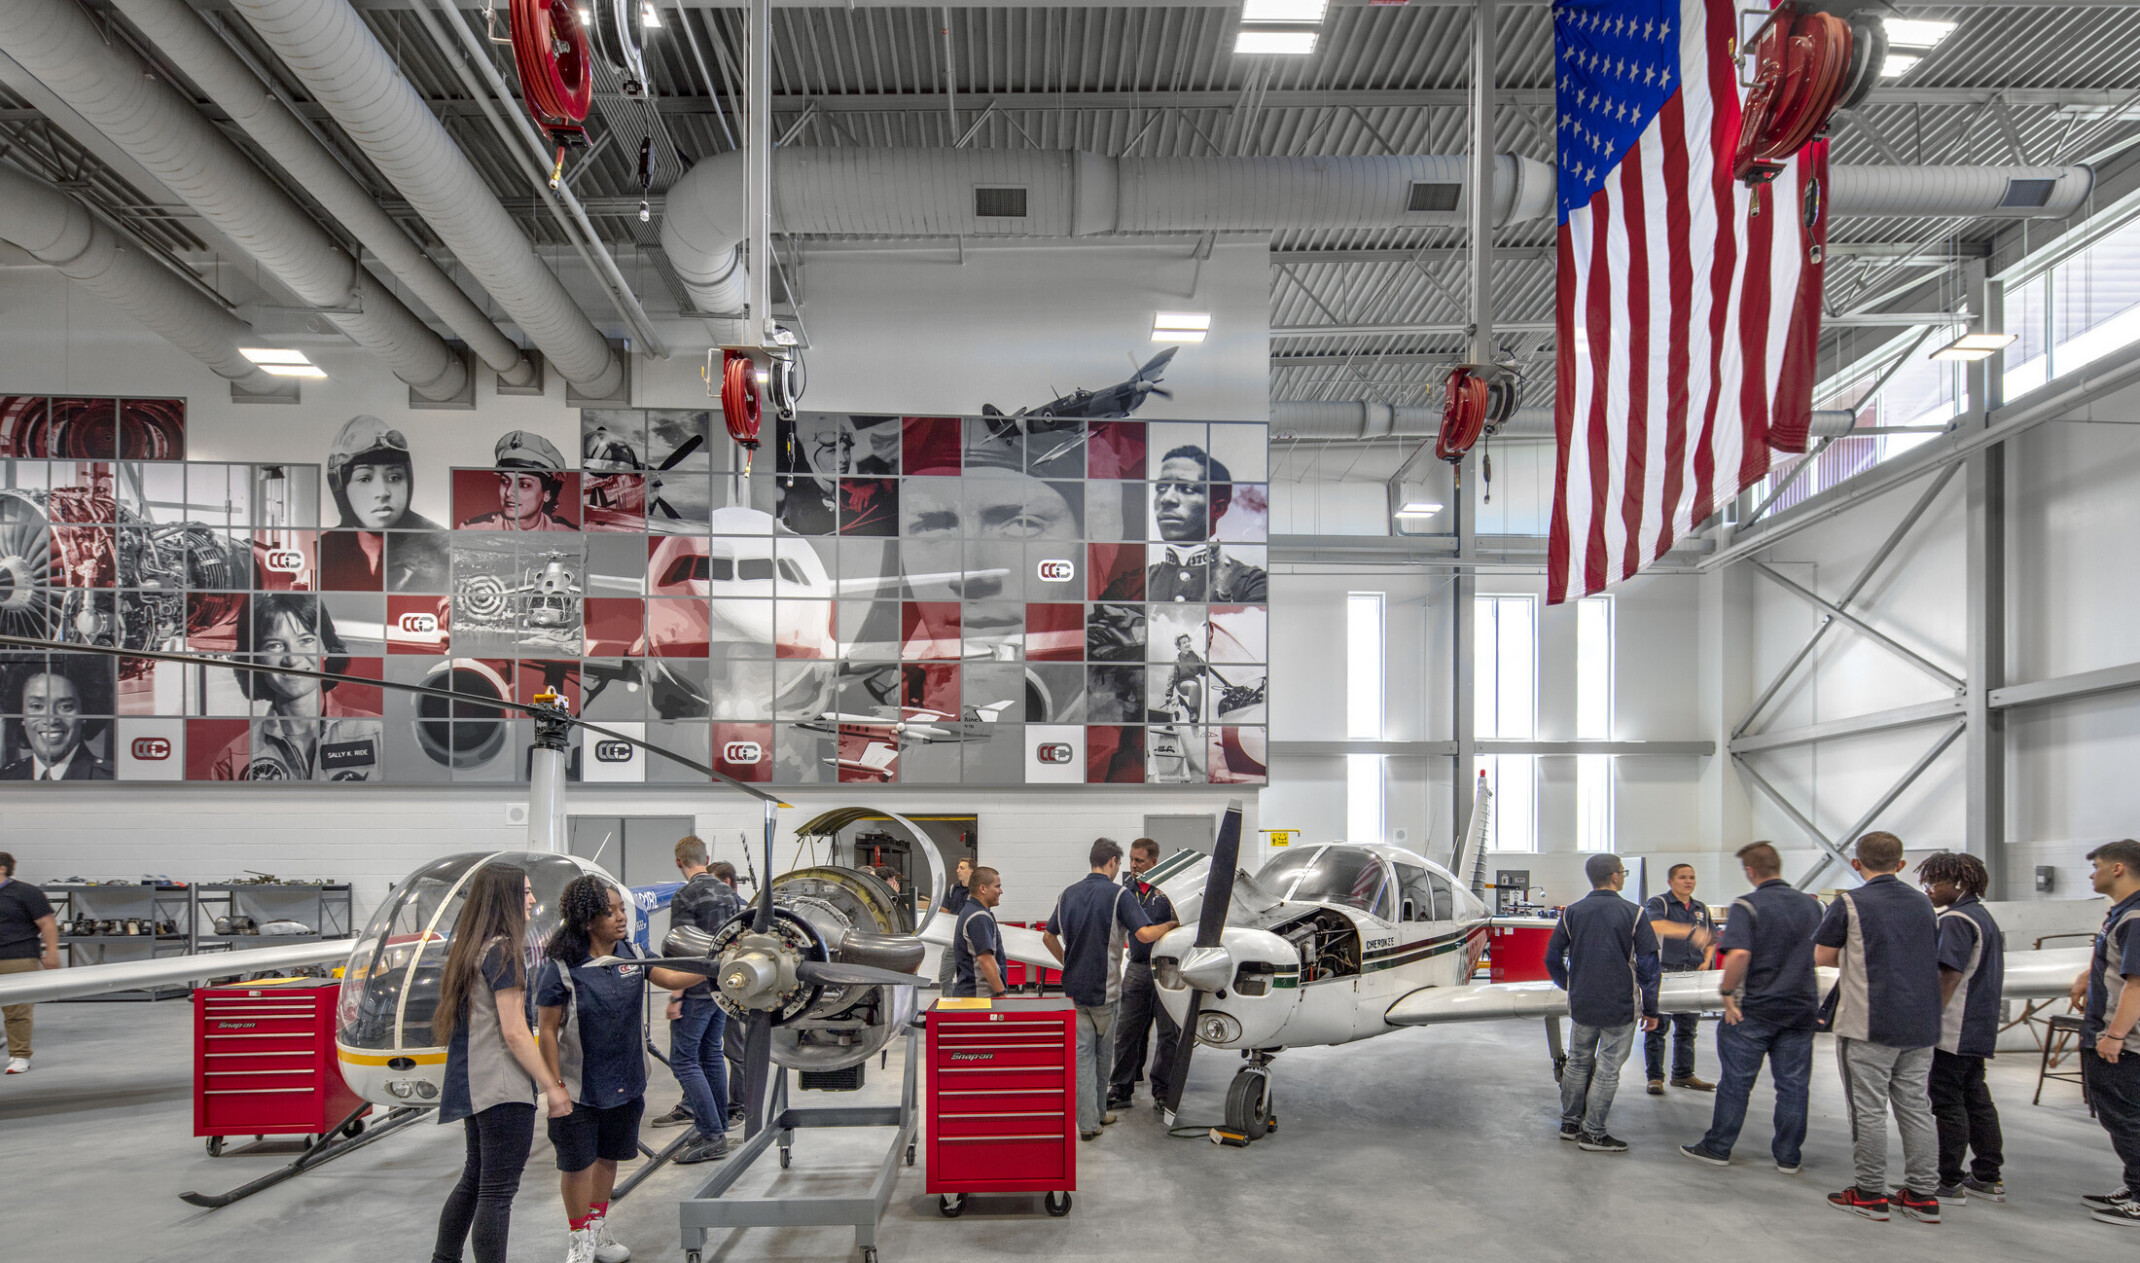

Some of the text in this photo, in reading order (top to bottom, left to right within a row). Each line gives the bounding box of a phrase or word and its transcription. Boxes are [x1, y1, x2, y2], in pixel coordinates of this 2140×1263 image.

[328, 751, 346, 759] SALLY
[354, 748, 369, 757] RIDE
[1366, 937, 1395, 950] CHEROKEE
[218, 1021, 256, 1030] Snap-on
[951, 1051, 994, 1062] Snap-on
